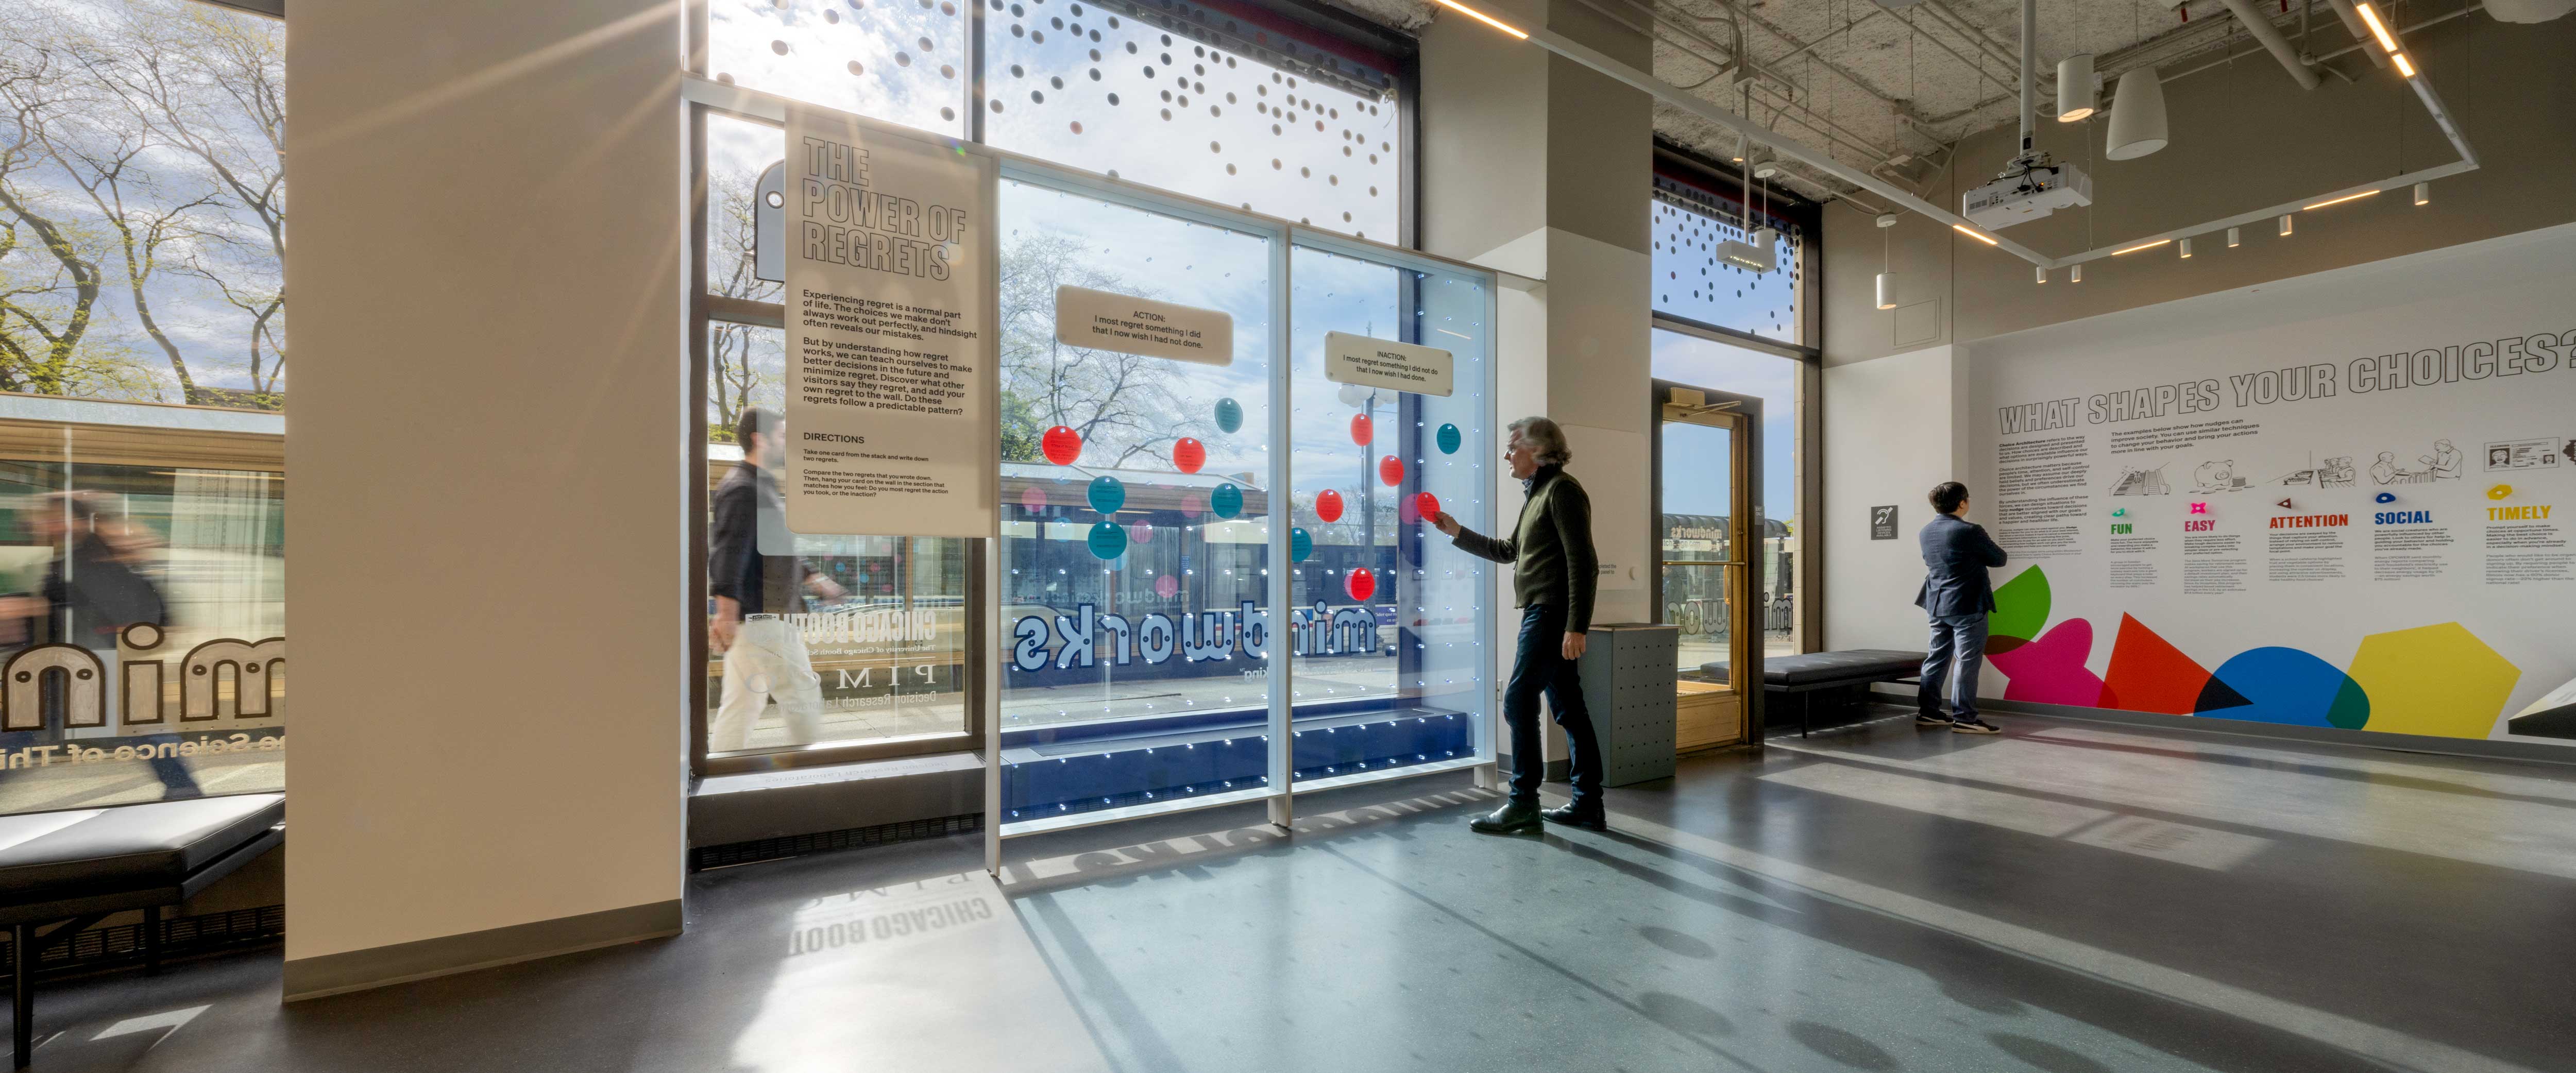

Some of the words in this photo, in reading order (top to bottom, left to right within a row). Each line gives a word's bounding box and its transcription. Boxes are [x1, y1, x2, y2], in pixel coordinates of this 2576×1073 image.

[803, 136, 869, 186] THE
[803, 178, 920, 237] POWER
[929, 205, 965, 244] OF
[803, 220, 949, 281] REGRETS
[803, 289, 865, 308] Experiencing
[867, 300, 894, 310] regret
[896, 302, 903, 311] is
[912, 306, 942, 316] normal
[944, 311, 961, 320] part
[803, 299, 812, 308] of
[815, 300, 832, 310] life.
[834, 303, 851, 313] The
[853, 306, 888, 318] choices
[905, 314, 928, 323] make
[929, 316, 951, 327] don't
[803, 309, 835, 321] always
[837, 314, 859, 323] work
[861, 317, 876, 326] out
[879, 320, 919, 333] perfectly,
[921, 325, 937, 333] and
[939, 326, 977, 340] hindsight
[1099, 317, 1119, 326] most
[1121, 321, 1144, 330] regret
[1145, 325, 1184, 337] something
[1189, 330, 1201, 338] did
[1133, 311, 1165, 322] ACTION:
[803, 318, 827, 328] often
[831, 323, 863, 333] reveals
[883, 329, 924, 340] mistakes.
[1092, 326, 1108, 334] that
[1131, 332, 1148, 340] wish
[1154, 335, 1168, 344] had
[1183, 339, 1203, 349] done.
[804, 336, 820, 346] But
[822, 339, 834, 350] by
[836, 342, 901, 358] understanding
[904, 349, 921, 359] how
[923, 353, 948, 362] regret
[1378, 351, 1406, 361] INACTION:
[803, 348, 834, 360] works,
[870, 354, 894, 364] teach
[896, 359, 938, 369] ourselves
[939, 362, 948, 370] to
[950, 364, 972, 373] make
[803, 355, 833, 366] better
[834, 359, 878, 371] decisions
[880, 364, 888, 372] in
[890, 365, 904, 374] the
[906, 367, 931, 377] future
[934, 371, 949, 379] and
[1380, 362, 1408, 372] something
[803, 375, 838, 386] visitors
[840, 380, 856, 389] say
[857, 380, 877, 391] they
[880, 384, 909, 395] regret,
[911, 386, 926, 395] and
[928, 388, 945, 396] add
[946, 390, 965, 399] your
[804, 366, 846, 377] minimize
[848, 372, 878, 381] regret.
[880, 373, 919, 385] Discover
[920, 378, 941, 387] what
[943, 380, 964, 389] other
[1411, 373, 1426, 382] done.
[1999, 398, 2080, 435] WHAT
[2088, 379, 2219, 424] SHAPES
[2230, 363, 2336, 407] YOUR
[2348, 329, 2576, 394] CHOICES?
[804, 396, 838, 405] regrets
[839, 397, 867, 407] follow
[876, 401, 926, 412] predictable
[928, 406, 963, 416] pattern?
[825, 388, 853, 397] regret
[855, 389, 865, 398] to
[867, 390, 881, 399] the
[883, 393, 903, 401] wall.
[905, 394, 917, 402] Do
[919, 395, 942, 405] these
[804, 432, 865, 444] DIRECTIONS
[2270, 514, 2348, 529] ATTENTION
[2375, 510, 2433, 524] SOCIAL
[2486, 505, 2551, 520] TIMELY
[2111, 524, 2132, 534] FUN
[2185, 520, 2215, 532] EASY
